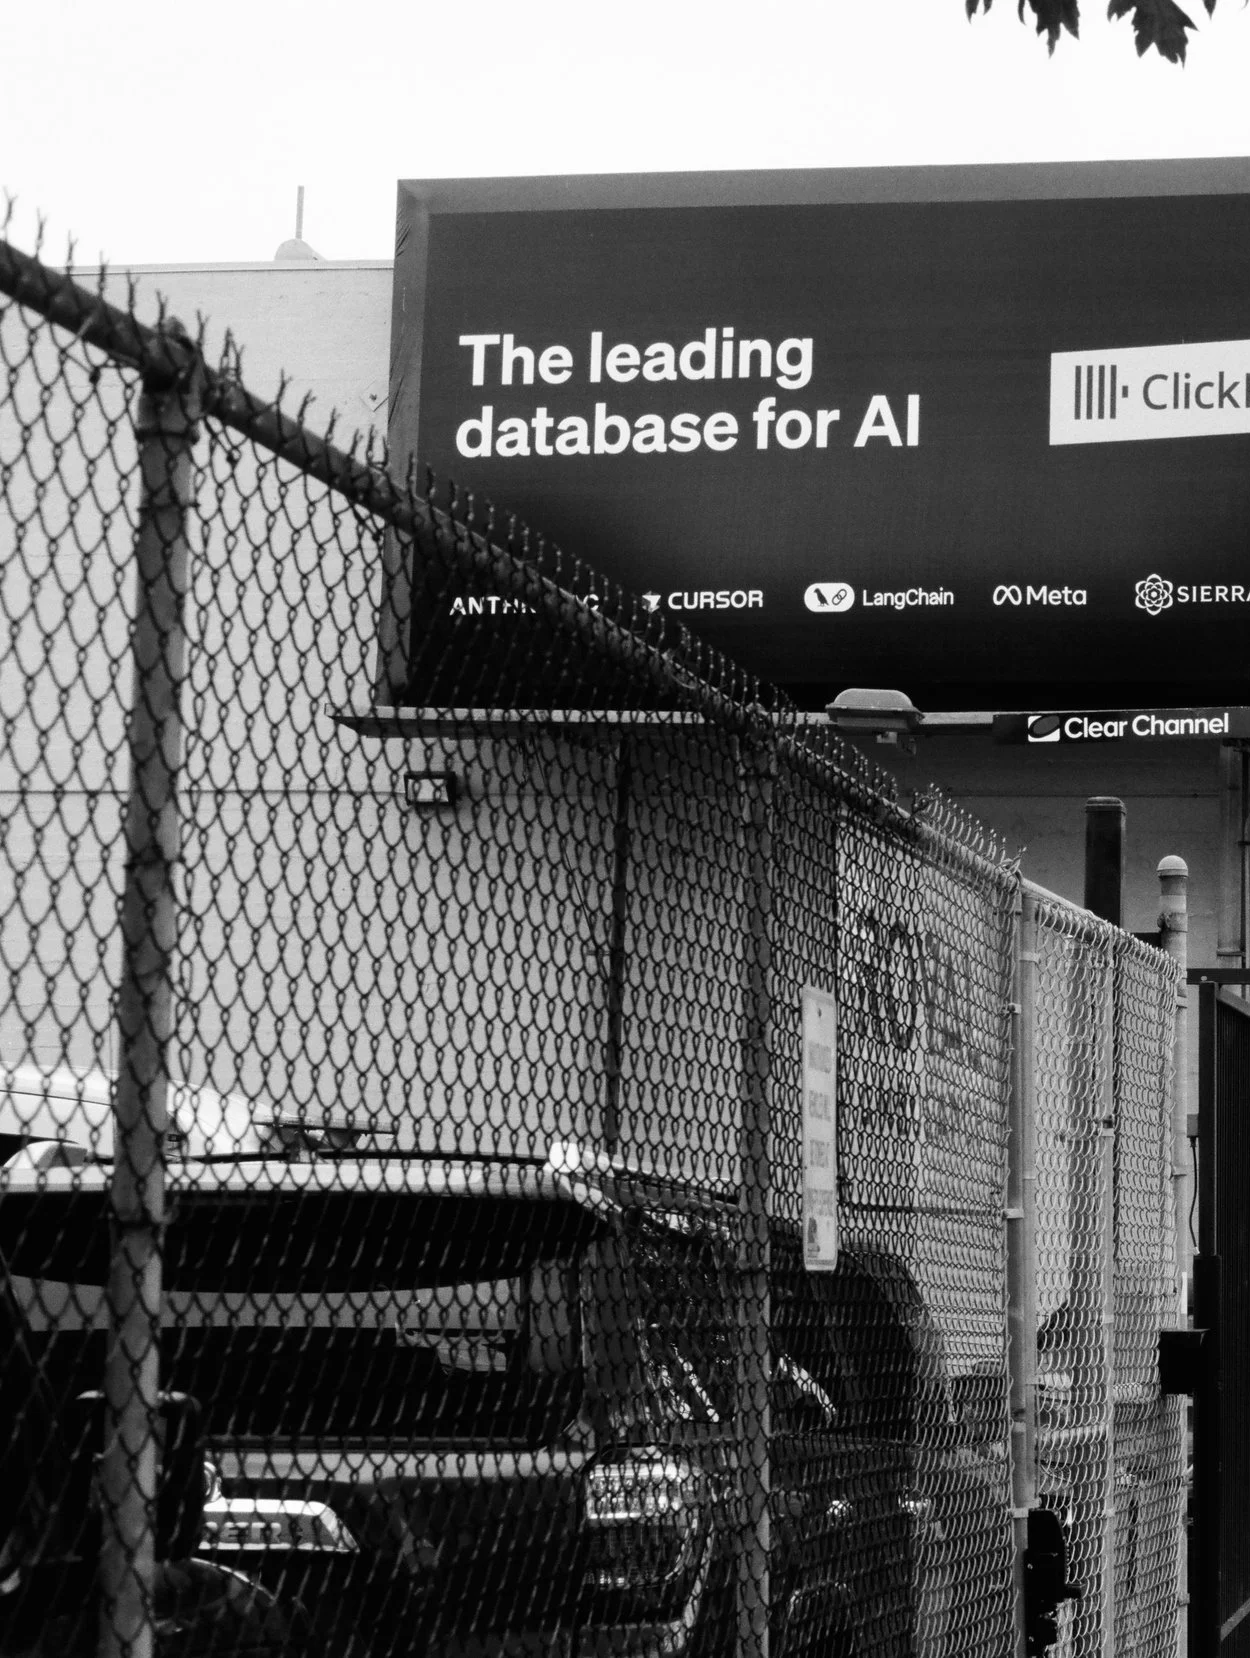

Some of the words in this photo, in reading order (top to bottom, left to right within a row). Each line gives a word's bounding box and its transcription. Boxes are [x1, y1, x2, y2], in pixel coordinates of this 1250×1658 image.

[459, 334, 573, 385] The
[590, 327, 813, 389] leading
[456, 403, 739, 458] database
[753, 397, 840, 449] for
[854, 395, 920, 447] AI
[668, 590, 764, 610] CURSOR
[862, 587, 954, 609] LangChain
[1026, 586, 1087, 606] Meta
[1064, 717, 1128, 739] Clear
[1132, 712, 1229, 737] Channel
